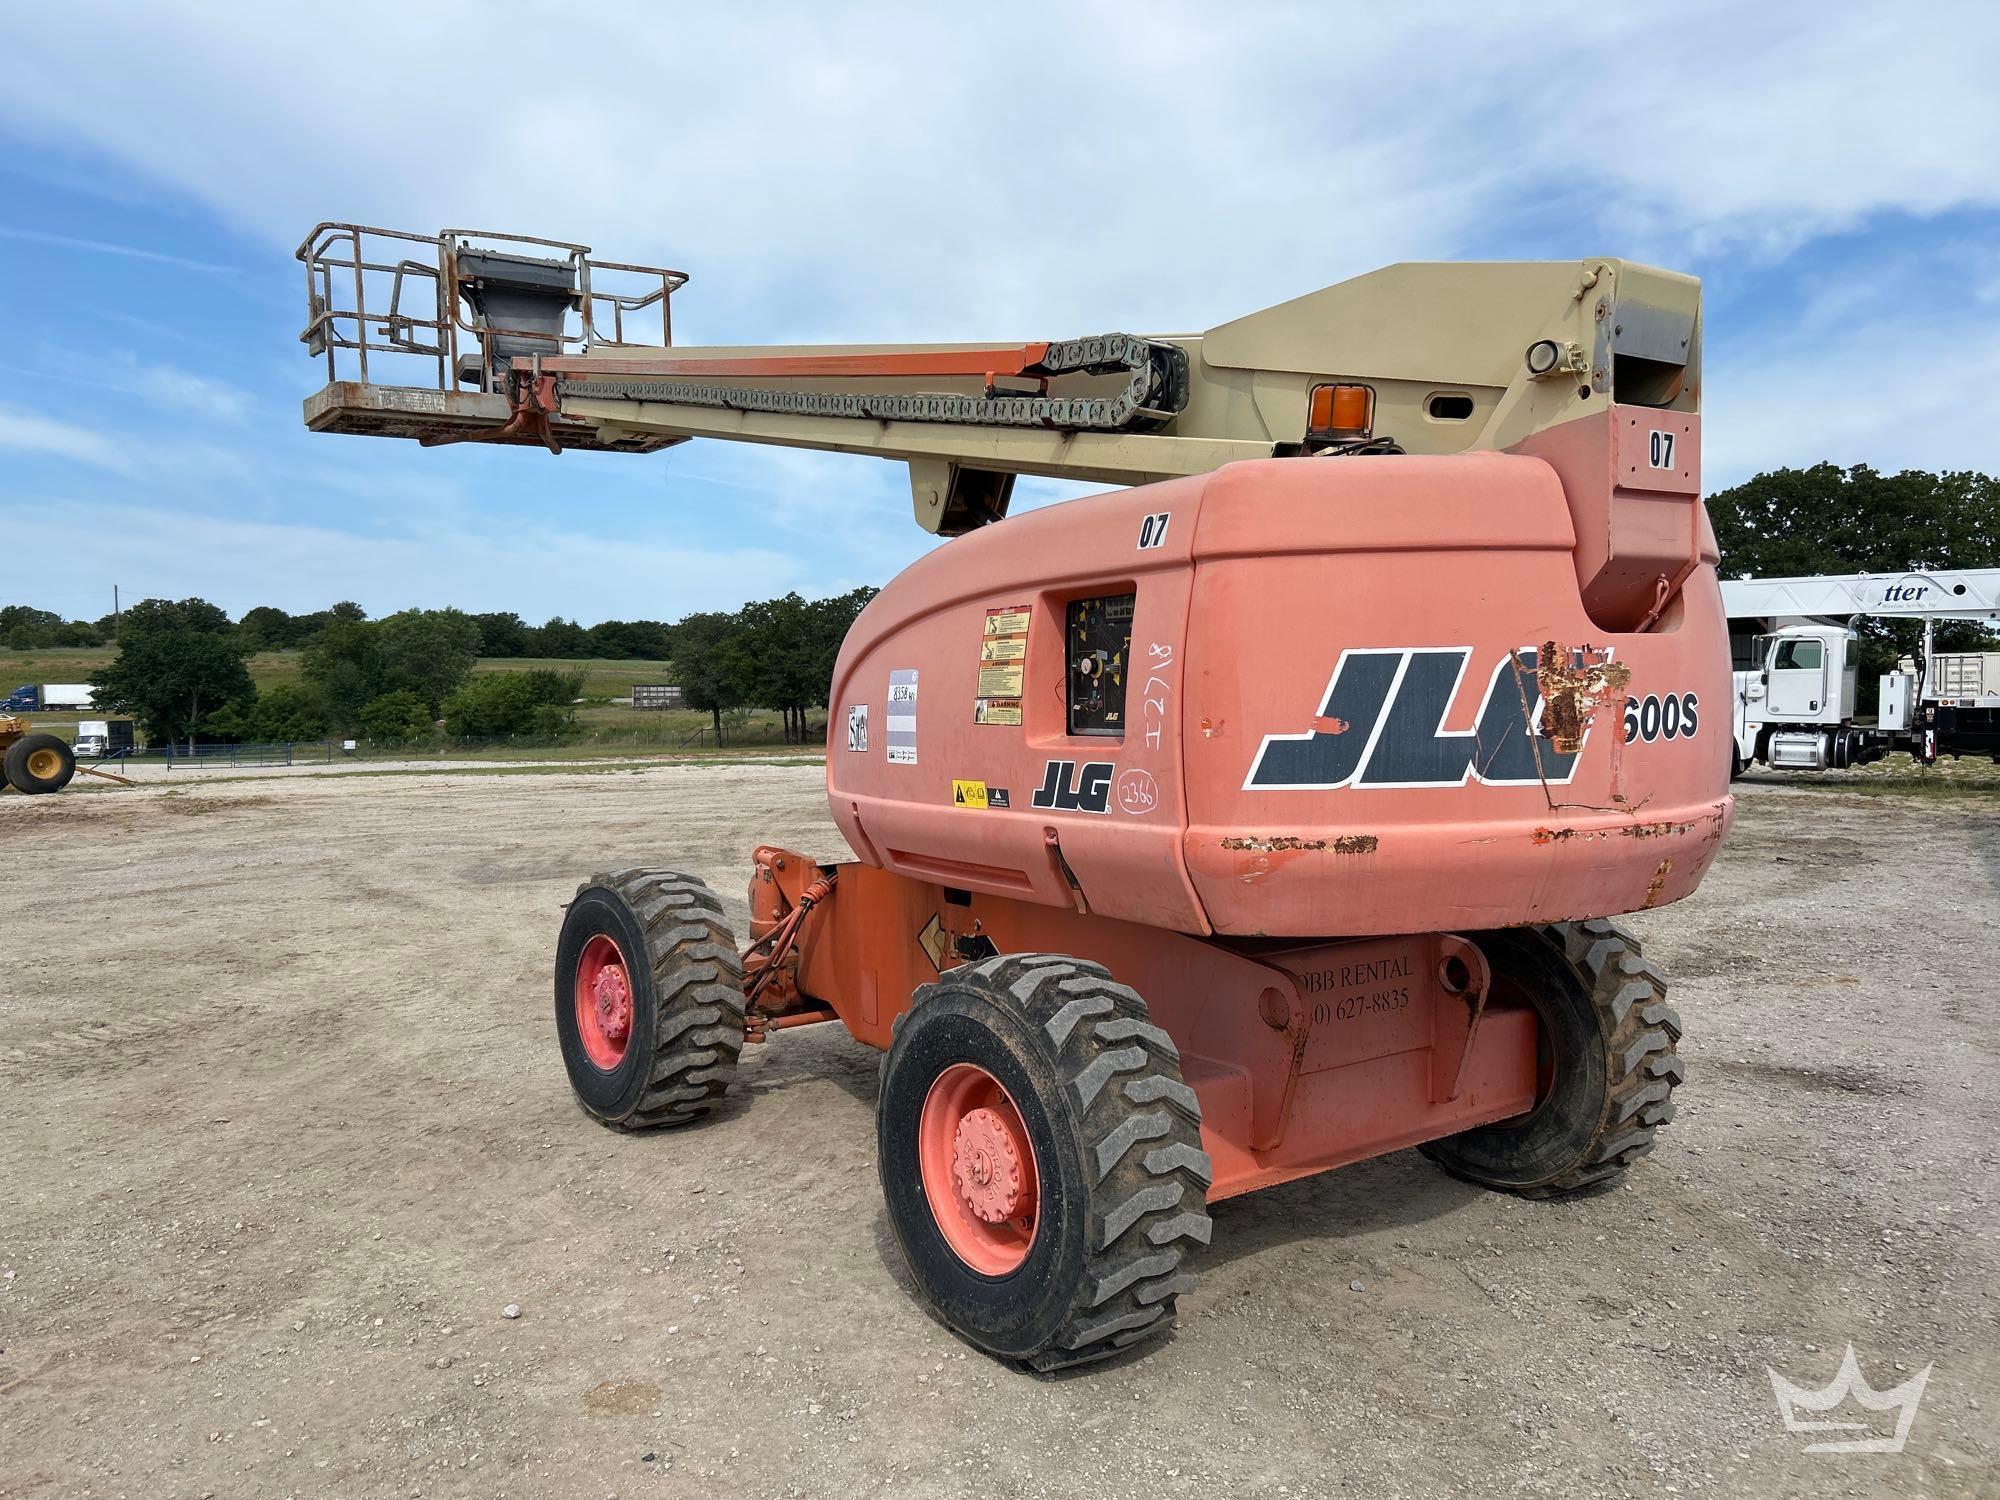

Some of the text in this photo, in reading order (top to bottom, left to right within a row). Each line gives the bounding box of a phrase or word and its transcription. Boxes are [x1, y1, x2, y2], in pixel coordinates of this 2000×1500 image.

[1650, 431, 1674, 468] 07
[1139, 513, 1169, 548] 07
[1884, 585, 1929, 602] tter
[1105, 712, 1119, 720] JLG
[1624, 692, 1699, 745] 600S
[1032, 760, 1115, 814] JLG
[1122, 779, 1153, 805] 2366
[1341, 956, 1414, 988] RENTAL
[1336, 986, 1409, 1022] 627-8835
